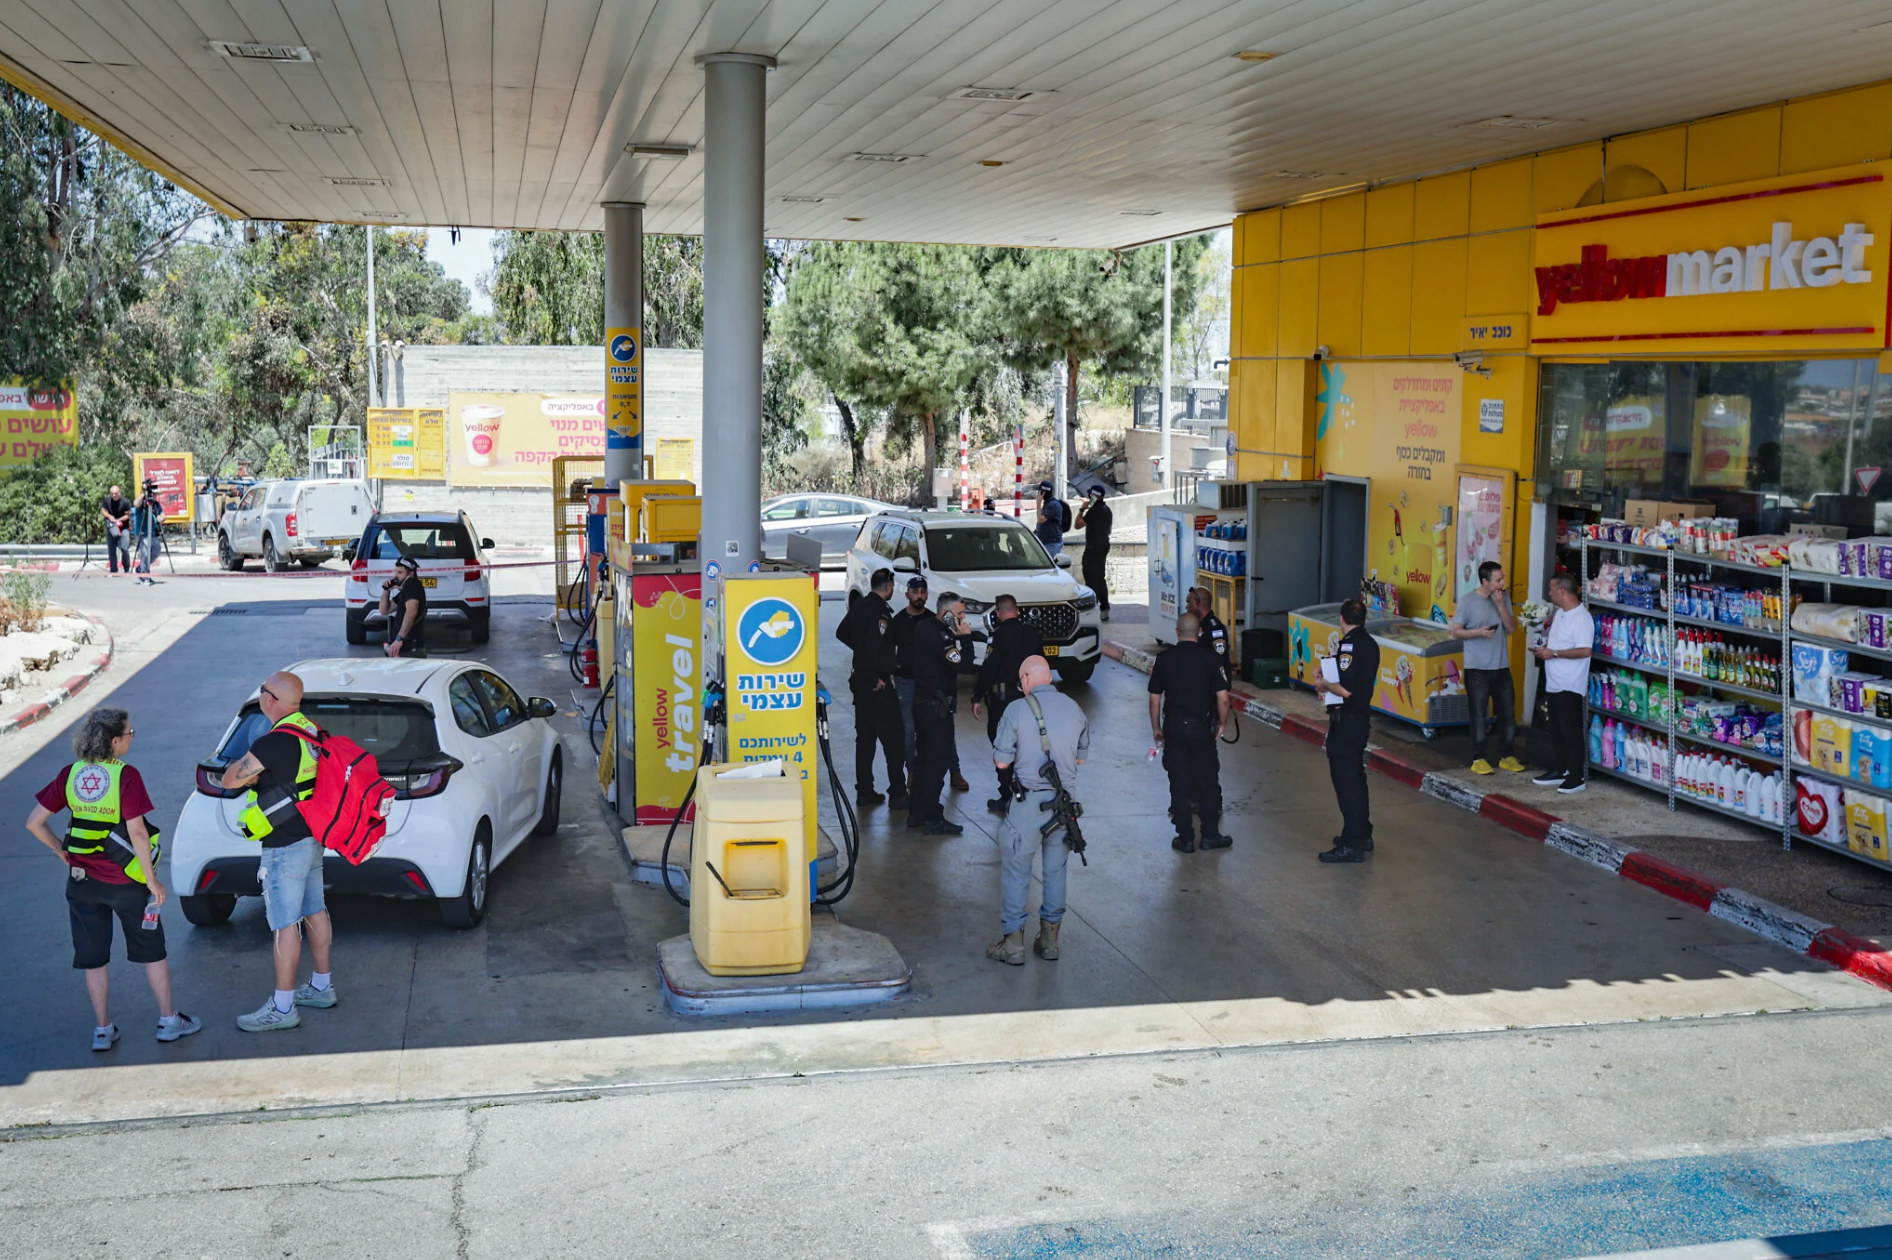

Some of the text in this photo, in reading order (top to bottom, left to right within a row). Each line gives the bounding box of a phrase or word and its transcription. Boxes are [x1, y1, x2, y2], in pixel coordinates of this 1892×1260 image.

[1492, 325, 1512, 339] כוכב
[610, 366, 638, 375] שירות
[611, 374, 638, 384] עצמי
[547, 402, 594, 412] באפליקציה
[8, 418, 73, 434] עושים
[465, 423, 500, 433] yellow
[550, 419, 578, 431] מנוי
[1404, 418, 1438, 440] yellow
[1396, 445, 1412, 462] כסף
[1408, 465, 1432, 481] בחזרה
[1405, 569, 1431, 584] yellow
[737, 672, 806, 691] שירות
[665, 633, 694, 773] travel
[740, 690, 804, 711] עצמי
[652, 688, 671, 750] yellow
[739, 733, 807, 750] לשירותכם
[792, 751, 803, 764] 4
[83, 805, 98, 814] DAVID
[98, 807, 116, 816] ADOM
